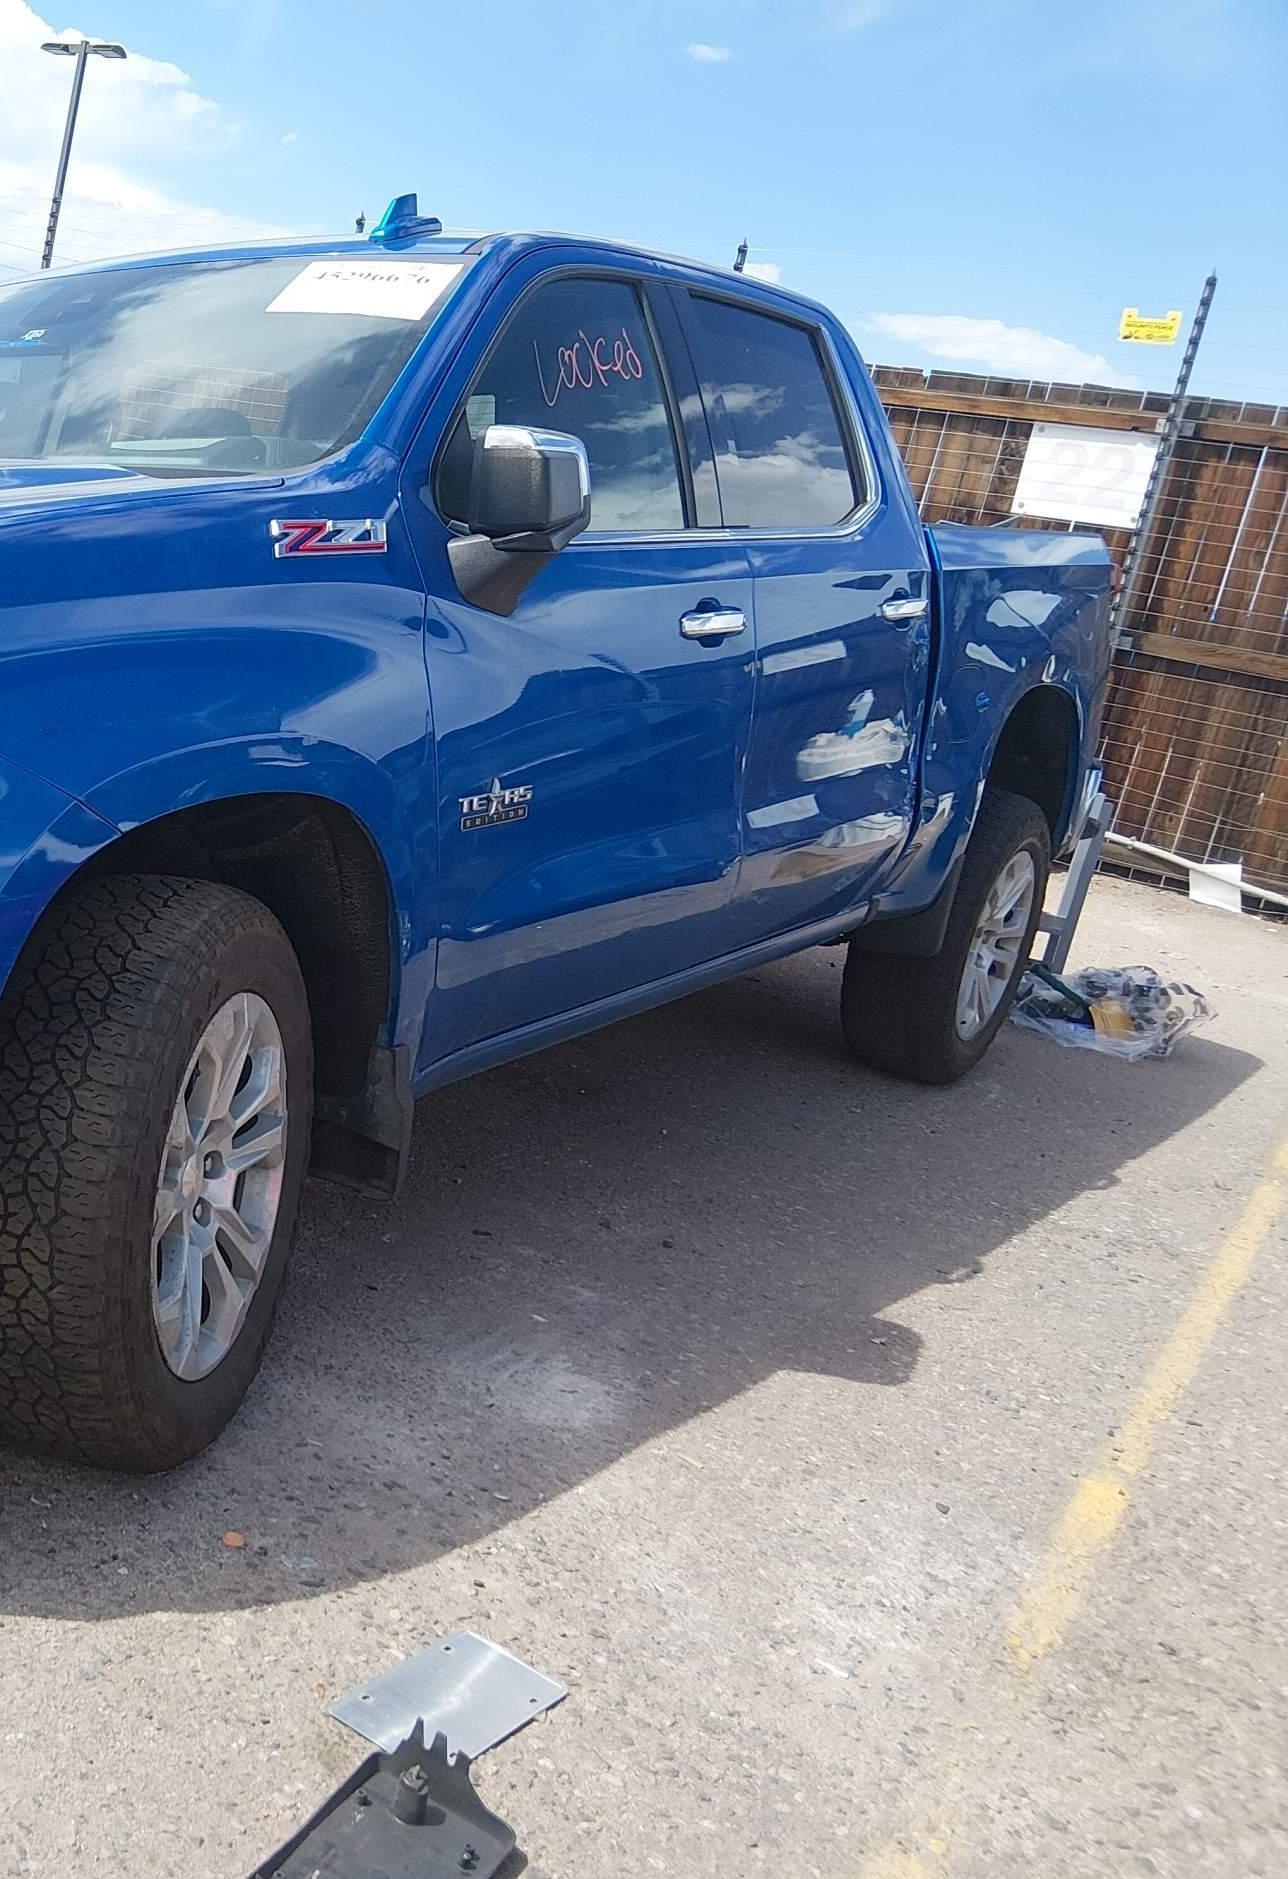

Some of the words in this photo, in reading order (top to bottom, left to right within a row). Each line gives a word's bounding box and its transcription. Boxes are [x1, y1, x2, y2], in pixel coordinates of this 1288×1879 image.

[1035, 441, 1136, 509] 22
[270, 519, 387, 558] Z71
[458, 778, 534, 815] TEXAS
[465, 809, 524, 829] EDITION
